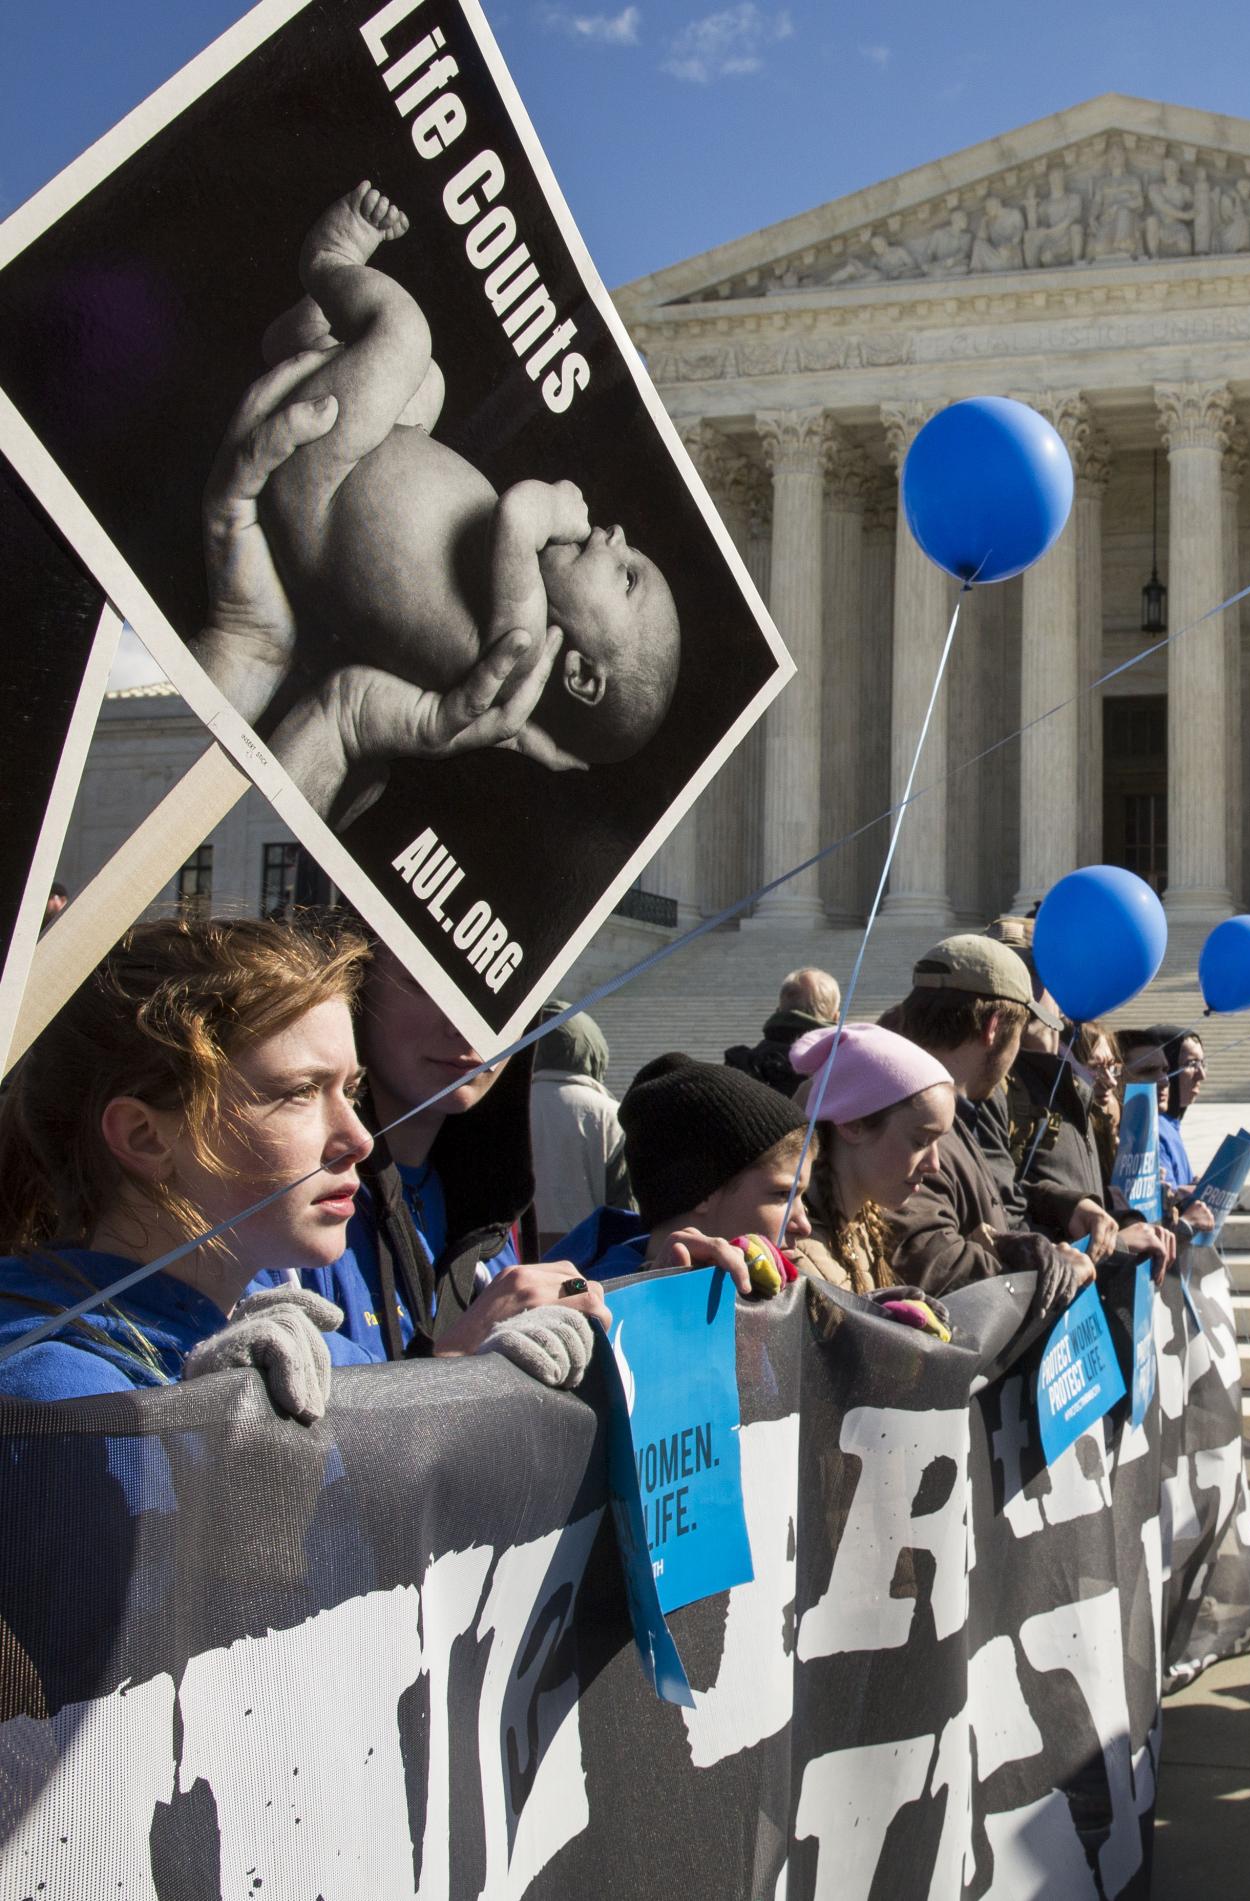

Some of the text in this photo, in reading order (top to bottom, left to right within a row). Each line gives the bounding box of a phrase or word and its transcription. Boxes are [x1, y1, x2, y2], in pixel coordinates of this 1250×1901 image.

[359, 0, 590, 414] Life Counts
[1038, 323, 1136, 347] JUSTICE
[1149, 315, 1240, 339] UNDER
[391, 827, 524, 994] AUL.ORG
[1042, 1333, 1072, 1389] PROTECT
[1048, 1359, 1086, 1416] PROTECT
